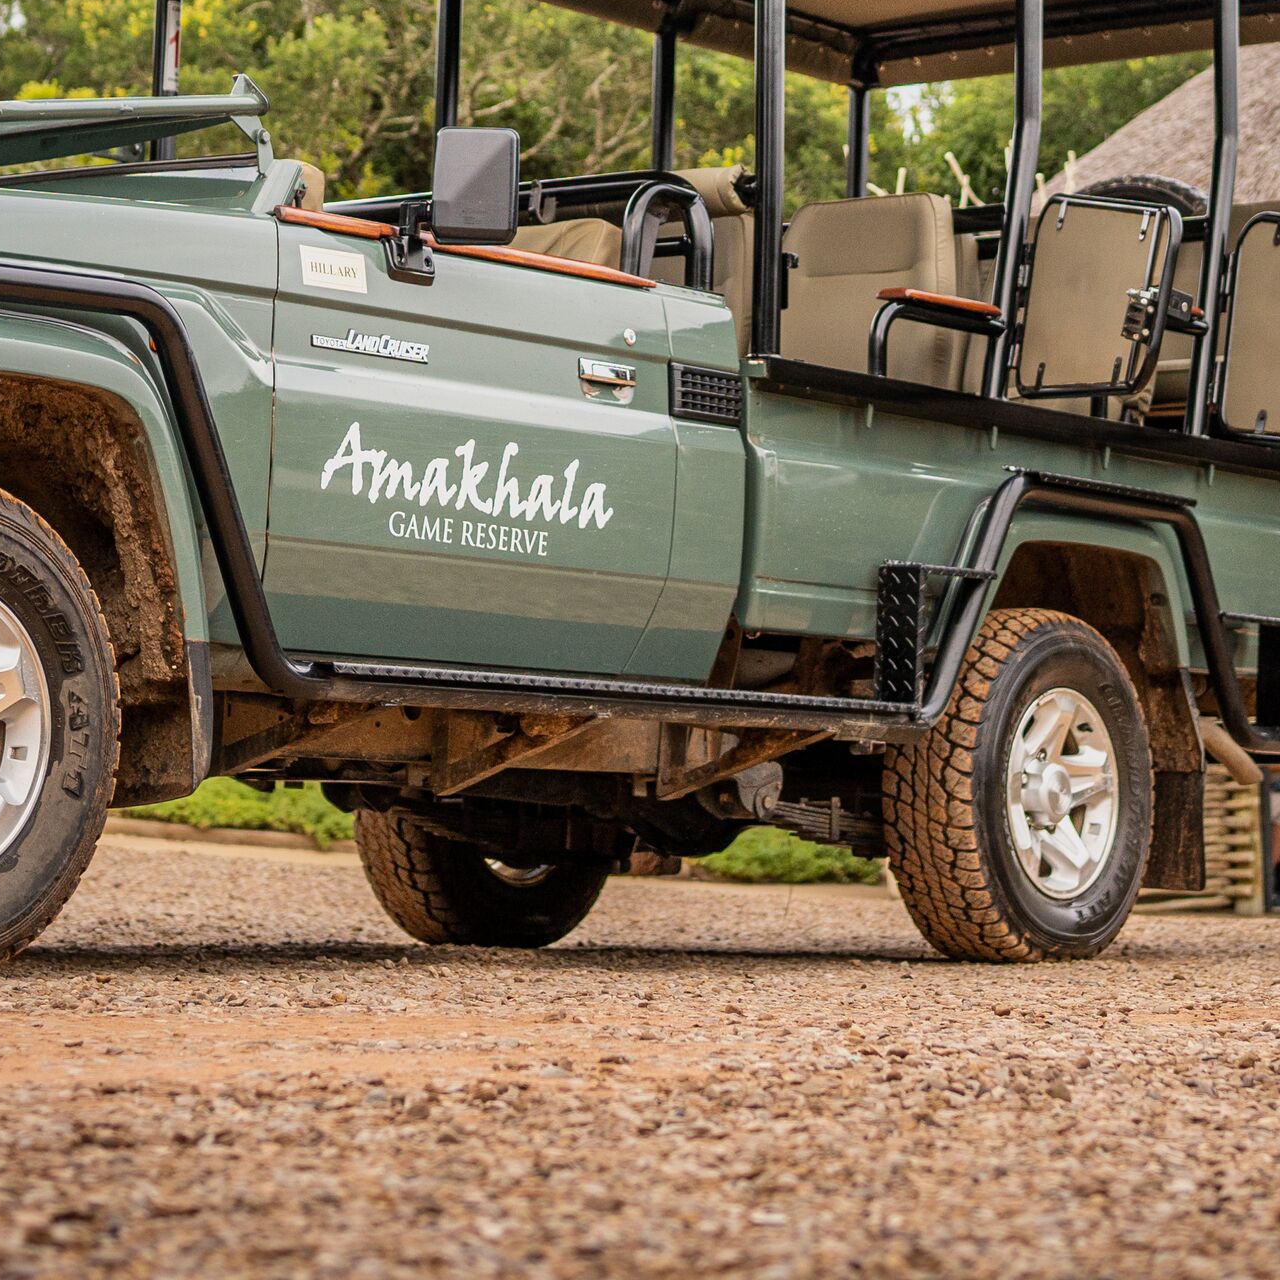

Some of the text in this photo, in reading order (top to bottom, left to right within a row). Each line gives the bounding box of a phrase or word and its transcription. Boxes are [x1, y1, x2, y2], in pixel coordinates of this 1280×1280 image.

[310, 261, 357, 278] HILLARY
[315, 336, 345, 348] TOYOTA
[320, 421, 614, 529] Amakhala
[388, 511, 549, 556] GAME RESERVE
